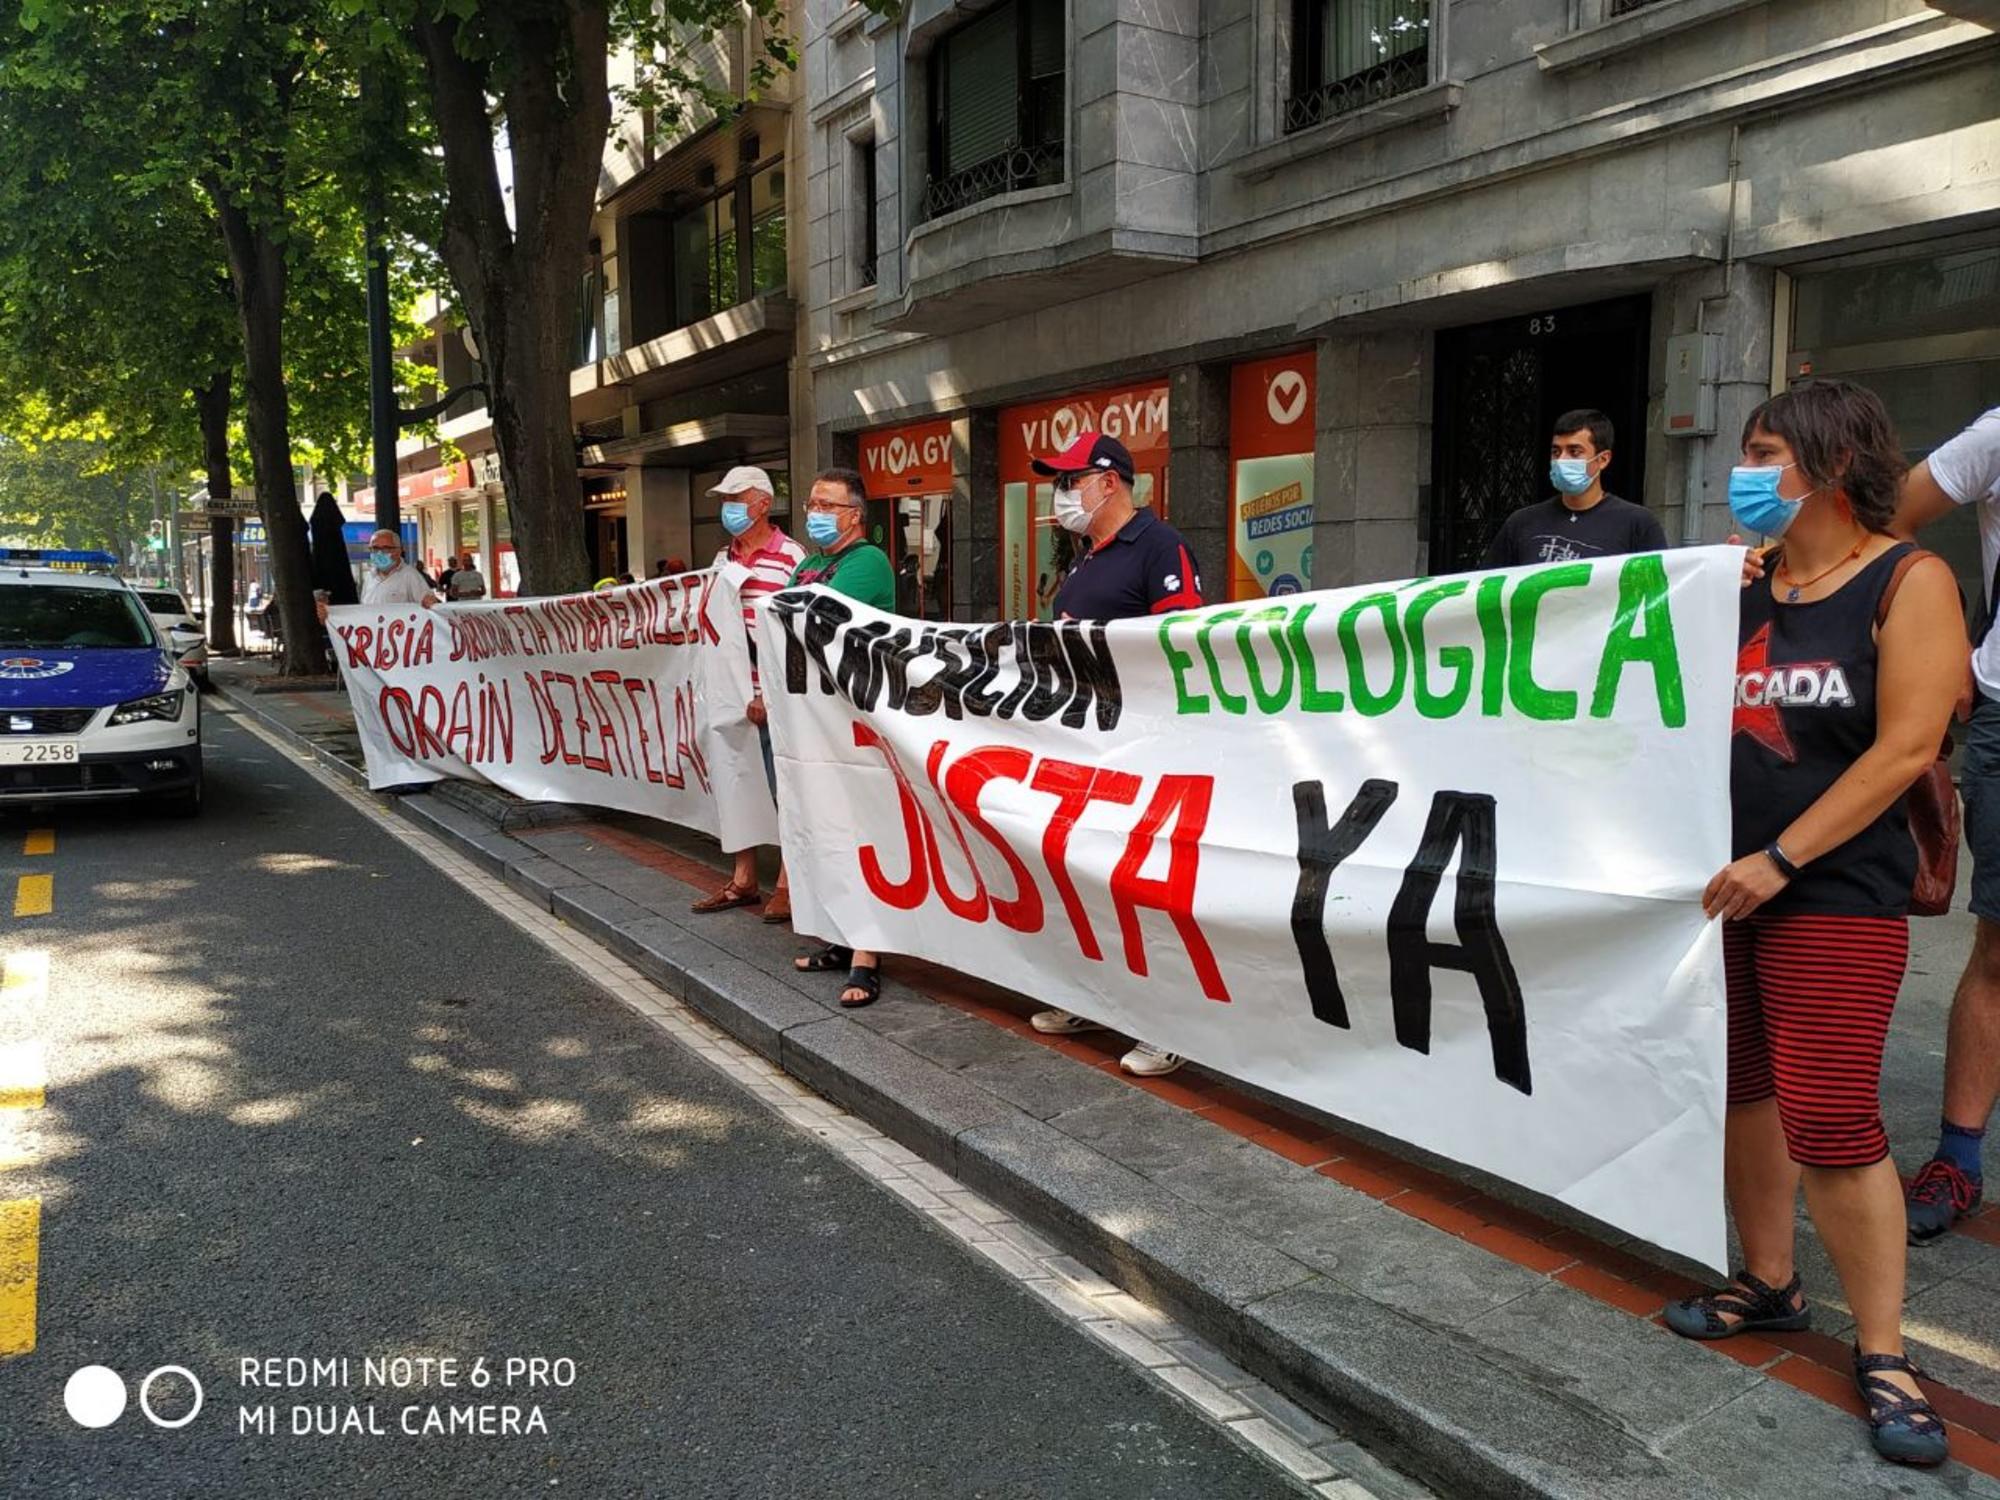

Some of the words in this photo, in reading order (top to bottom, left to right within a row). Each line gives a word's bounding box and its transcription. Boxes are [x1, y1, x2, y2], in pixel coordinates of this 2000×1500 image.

[1529, 316, 1556, 335] 83
[1101, 397, 1169, 438] GYM
[1250, 515, 1283, 537] REDES
[23, 744, 75, 762] 2258
[852, 720, 1231, 1003] JUSTA
[1291, 778, 1532, 1096] YA
